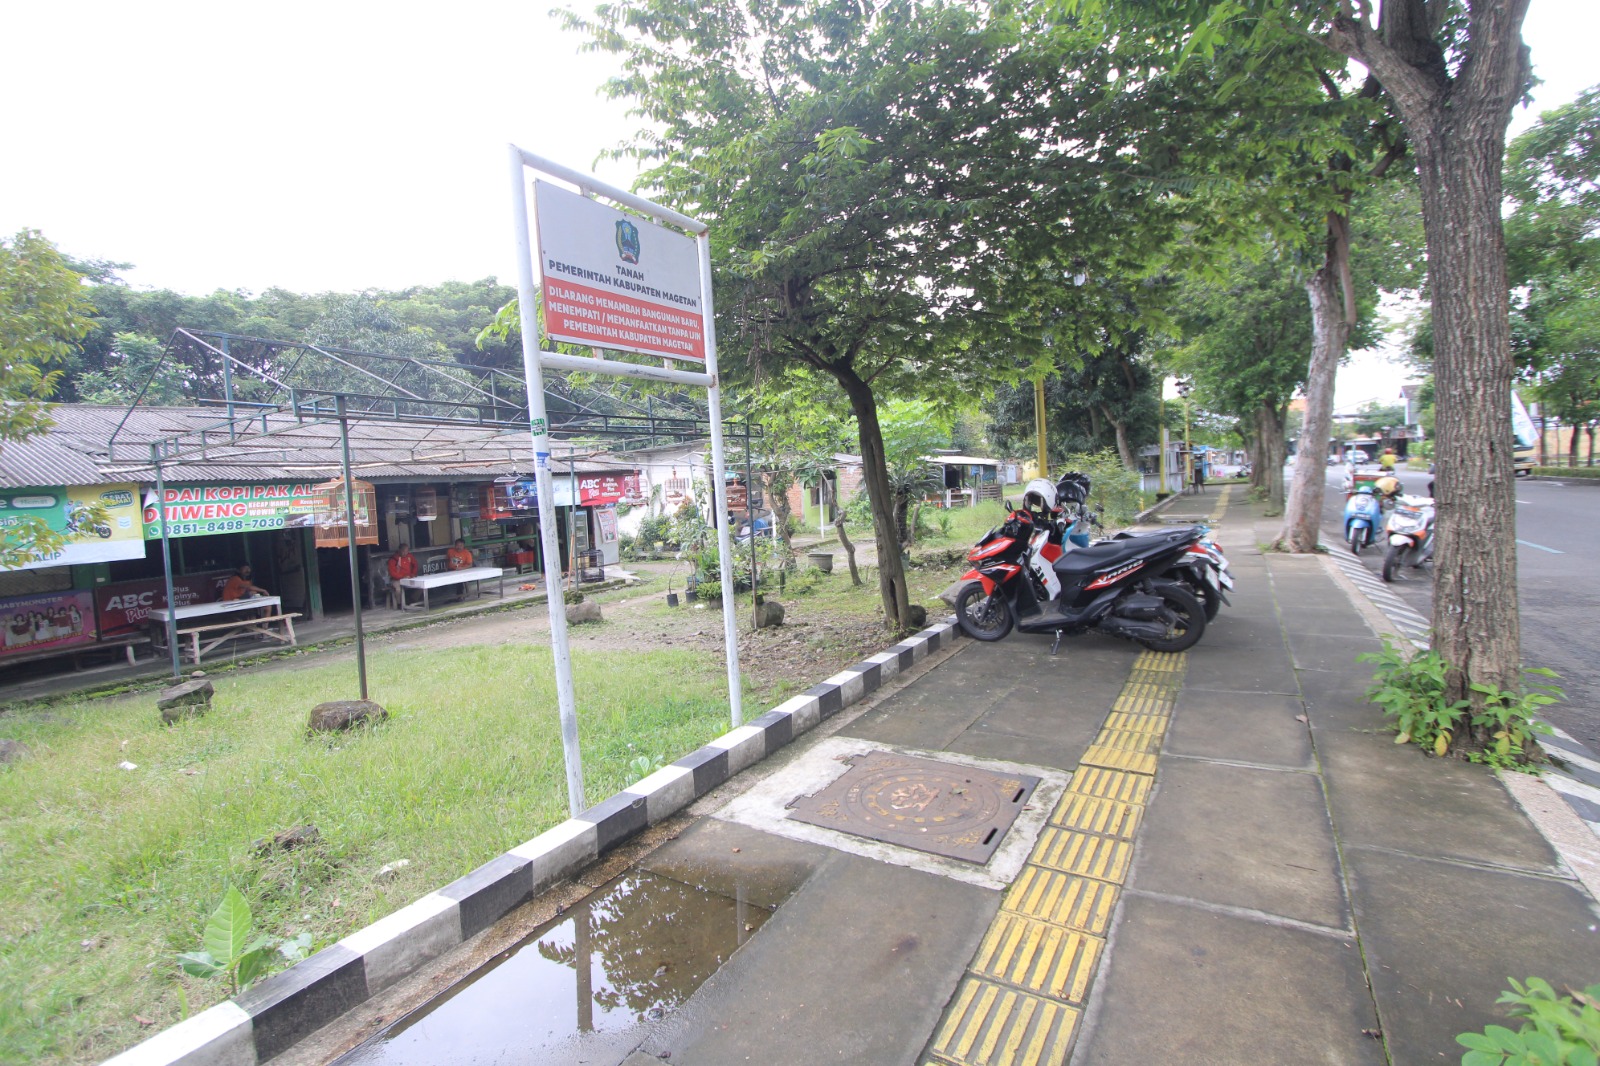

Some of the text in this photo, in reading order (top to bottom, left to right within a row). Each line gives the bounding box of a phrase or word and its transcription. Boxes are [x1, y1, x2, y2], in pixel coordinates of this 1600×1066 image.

[616, 265, 644, 281] TANAH
[549, 260, 697, 307] PEMERINTAH KABUPATEN MAGETAN
[549, 286, 700, 329] DILARANG MENAMBAH BANGUNAN BARU,
[549, 301, 701, 340] MENEMPATI / MEMANFAATKAN TANPA IJIN
[563, 319, 693, 351] PEMERINTAH KABUPATEN MAGETAN
[205, 486, 250, 500] KOPI
[254, 485, 291, 498] PAK
[580, 479, 600, 489] ABC
[143, 503, 247, 524] DJIWENG
[249, 508, 276, 516] WOWIN
[166, 518, 284, 535] 0851-8498-7030
[423, 562, 440, 573] RASA
[105, 592, 153, 611] ABC
